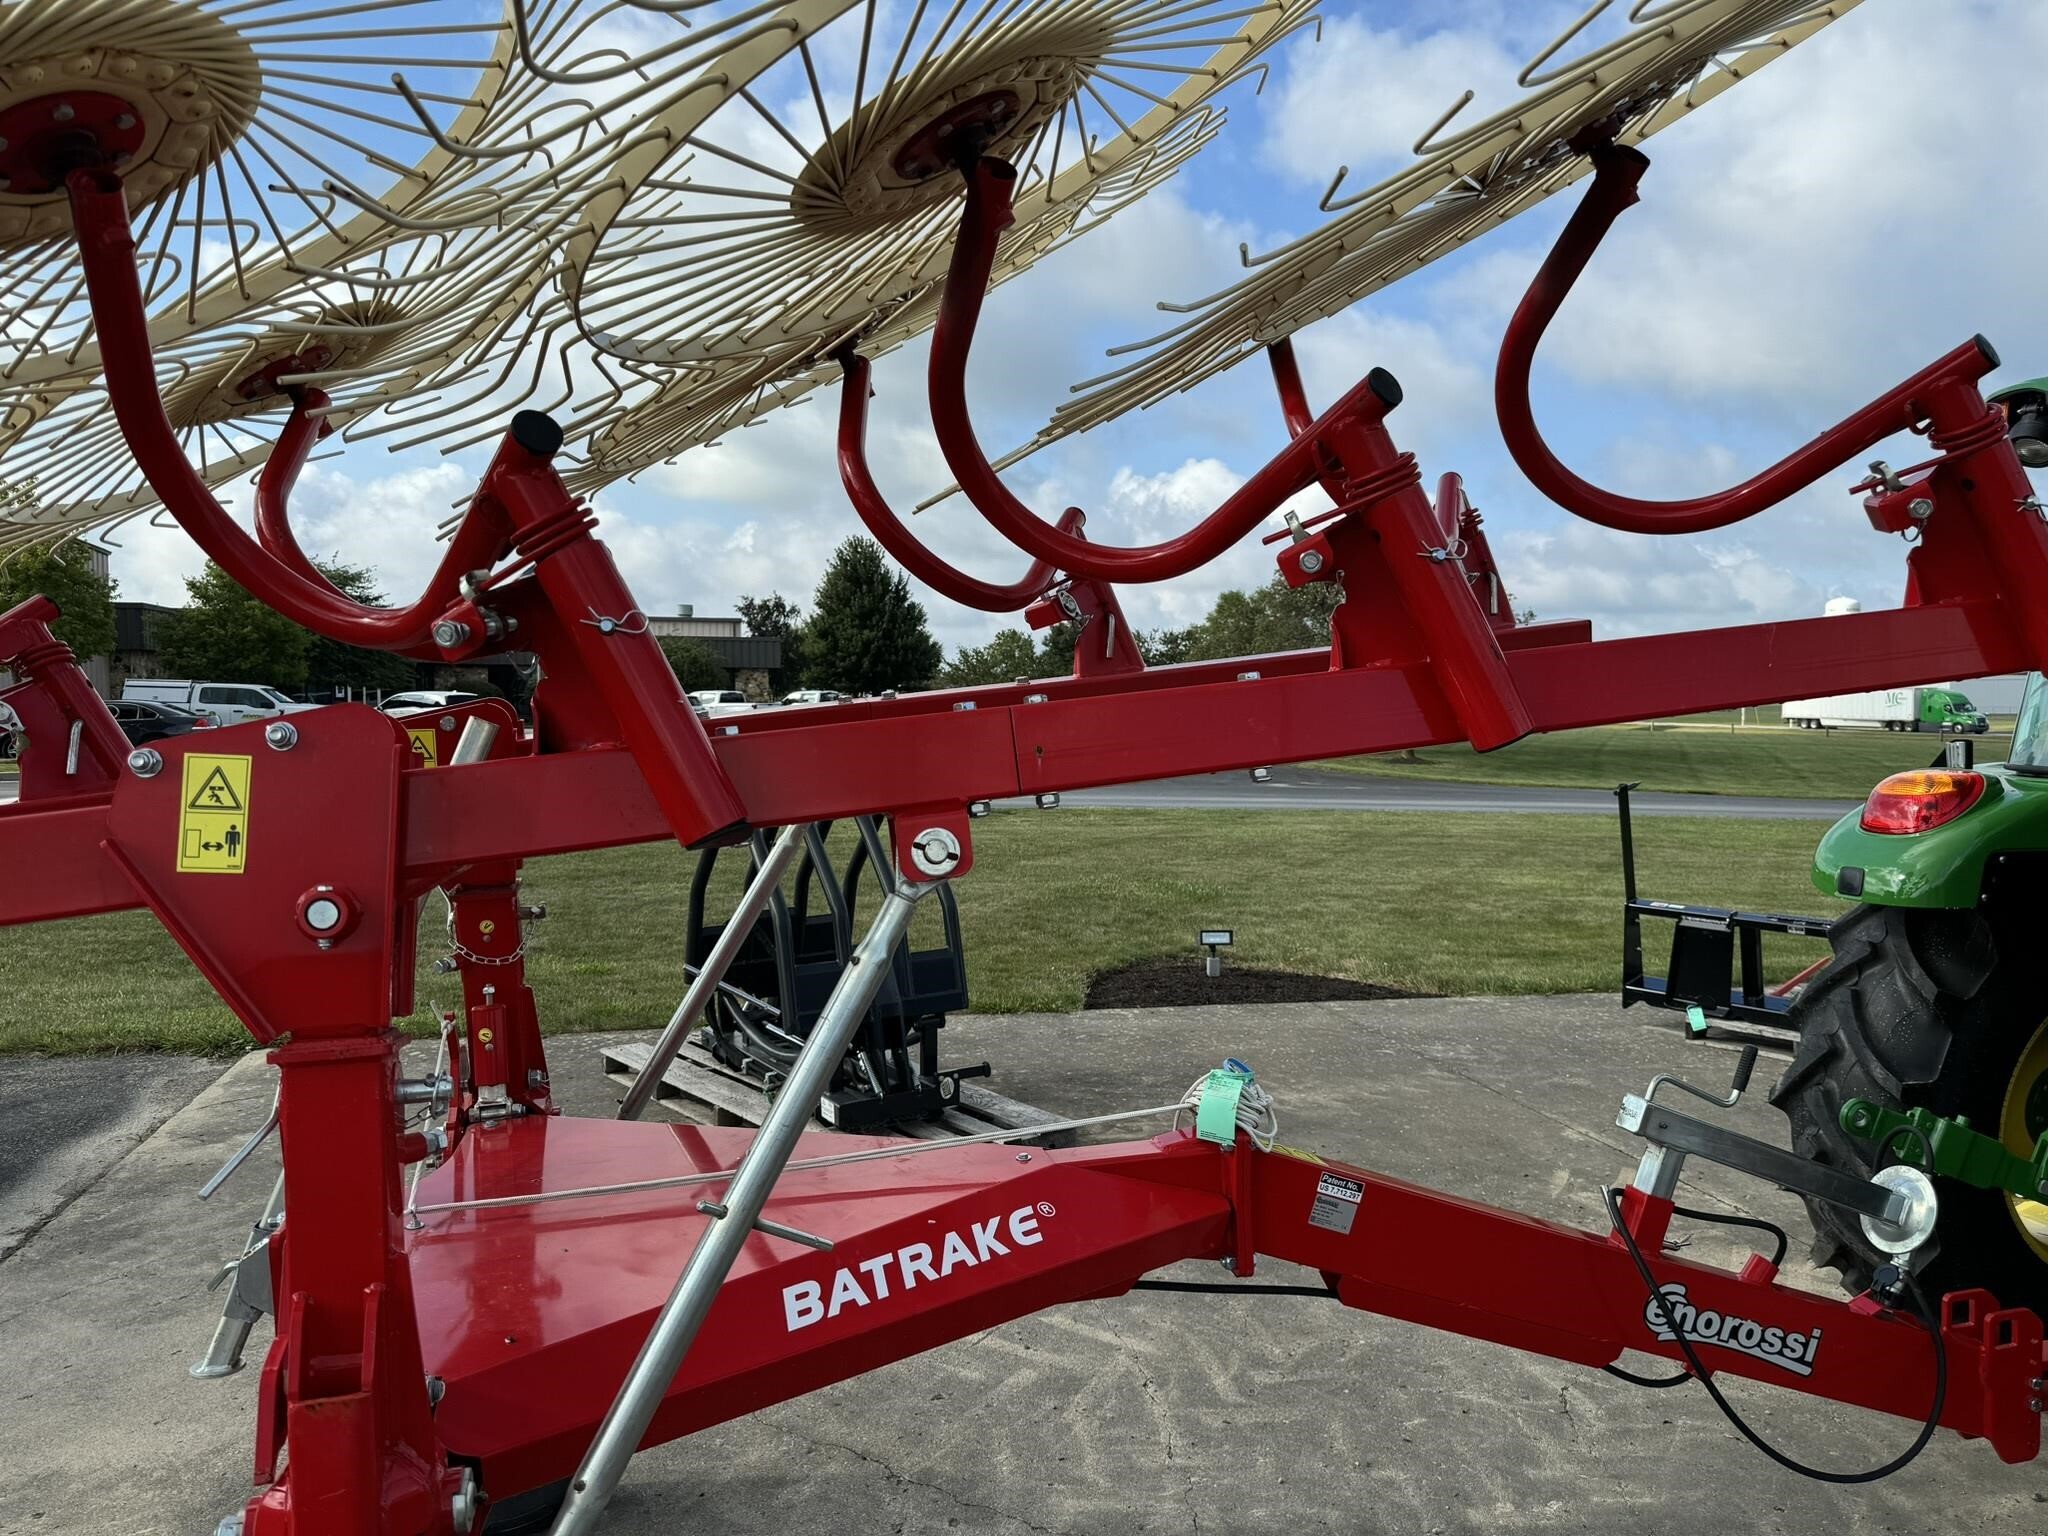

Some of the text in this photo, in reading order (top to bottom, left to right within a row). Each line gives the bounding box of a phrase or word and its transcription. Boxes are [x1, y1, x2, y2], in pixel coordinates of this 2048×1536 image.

[1319, 1184, 1330, 1192] US
[1322, 1175, 1358, 1191] Patent No.
